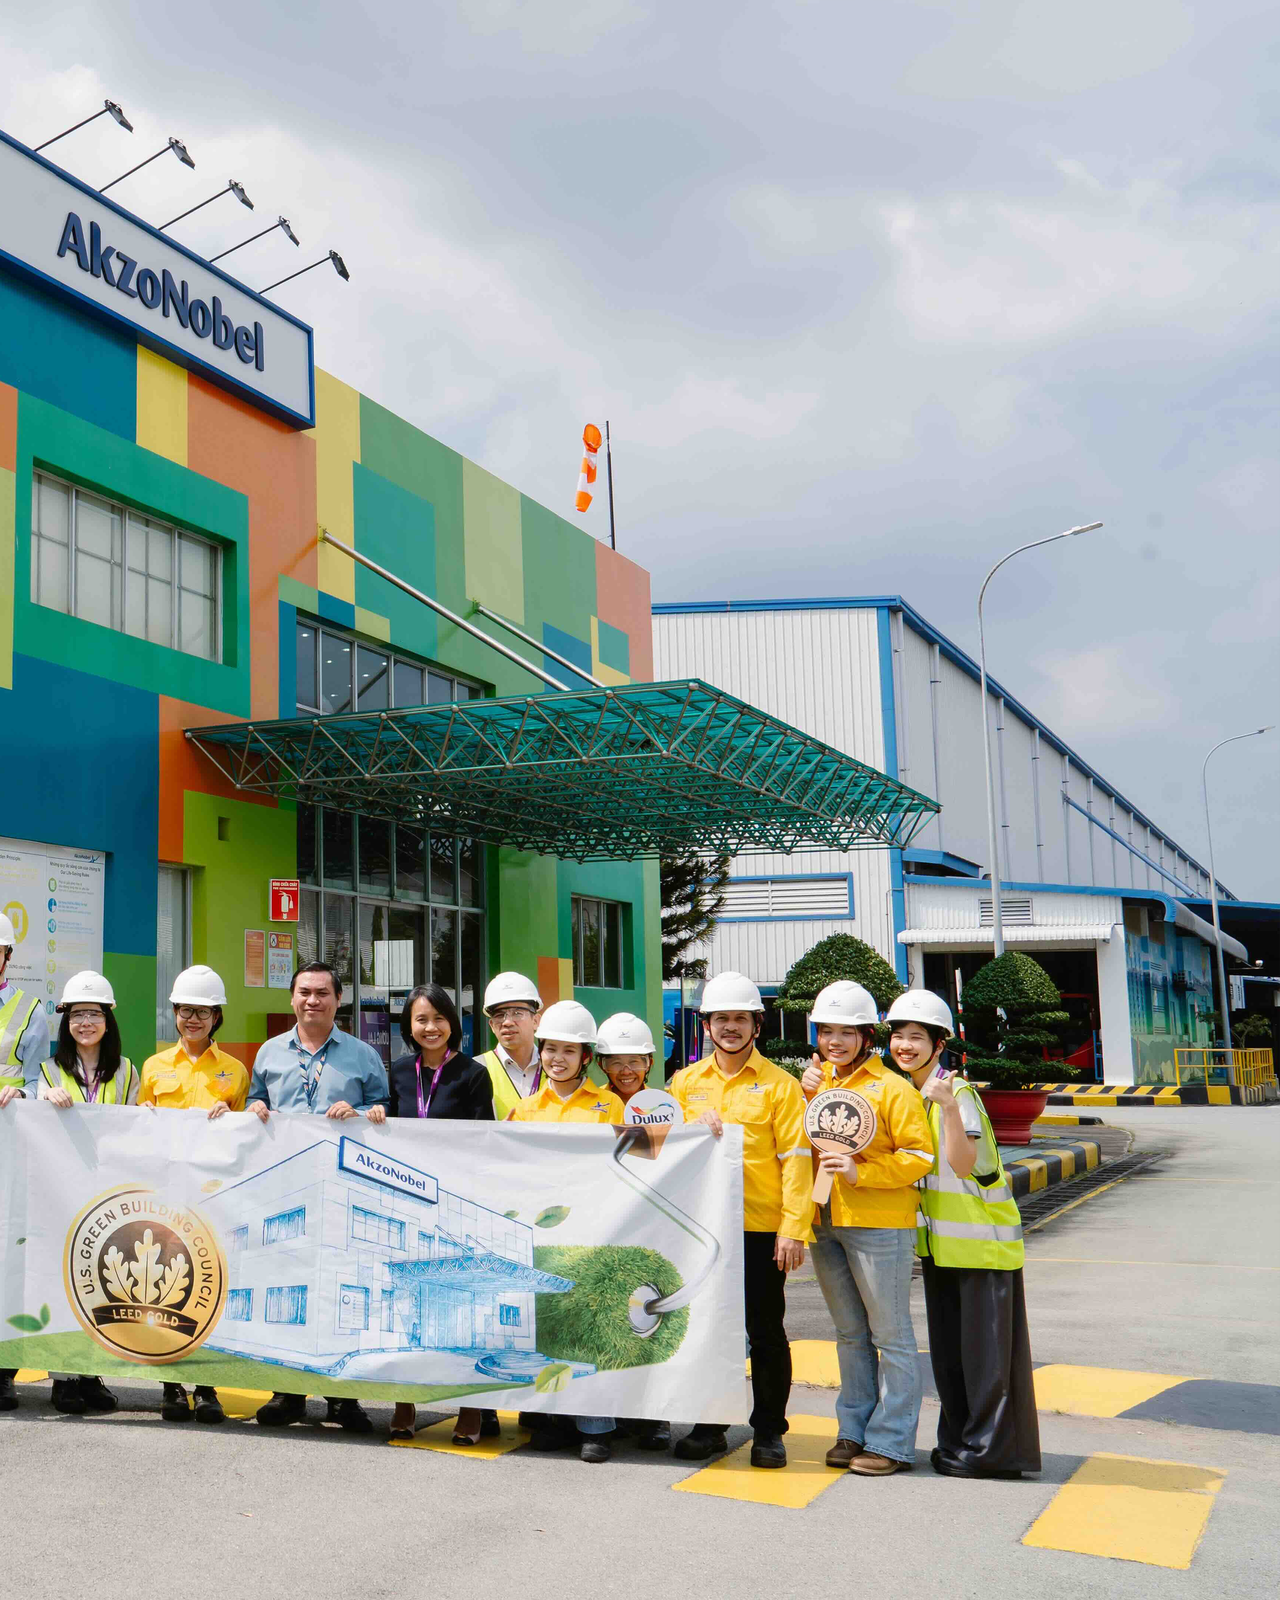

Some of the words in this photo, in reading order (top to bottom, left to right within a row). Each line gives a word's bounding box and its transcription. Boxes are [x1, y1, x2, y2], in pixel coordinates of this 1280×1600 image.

[56, 211, 265, 372] AkzoNobel
[360, 996, 385, 1005] kzoNobel
[631, 1113, 670, 1124] Dulux
[812, 1095, 831, 1113] GREEN
[832, 1092, 865, 1110] BUILDING
[858, 1111, 871, 1140] COUNCIL
[819, 1132, 834, 1140] LEED
[835, 1135, 850, 1145] GOLD
[355, 1153, 426, 1191] AkzoNobel
[80, 1208, 118, 1260] GREEN
[119, 1200, 194, 1234] BUILDING
[80, 1264, 95, 1296] U.S.
[192, 1235, 214, 1310] COUNCIL
[112, 1308, 142, 1319] LEED
[147, 1310, 179, 1327] GOLD
